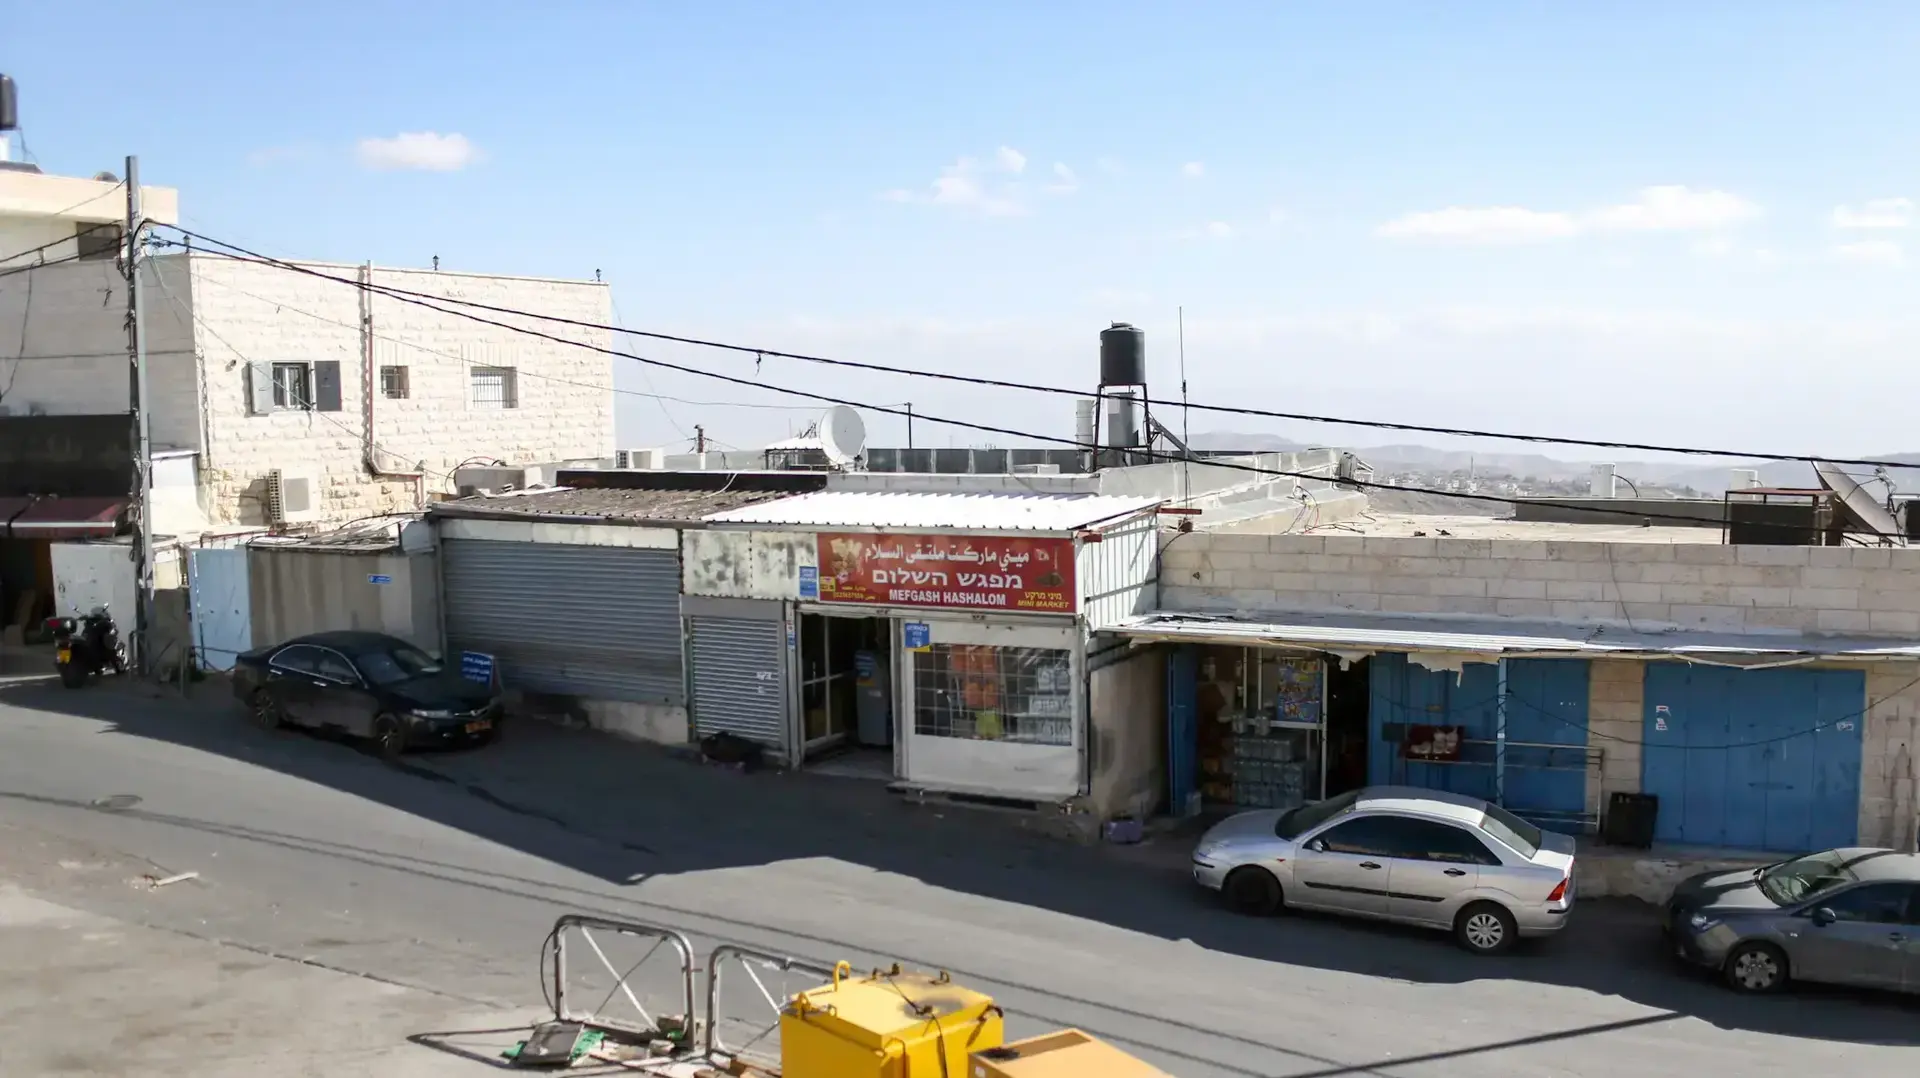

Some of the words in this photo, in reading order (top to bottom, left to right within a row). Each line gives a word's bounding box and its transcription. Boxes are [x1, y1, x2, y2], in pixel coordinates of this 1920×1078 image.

[864, 543, 904, 563] السلام
[948, 544, 997, 566] ماركت
[999, 547, 1030, 572] ميني
[871, 567, 948, 586] השלום
[956, 571, 1023, 590] מפגש
[889, 588, 941, 603] MEFGASH
[943, 590, 1007, 606] HASHALOM
[1017, 599, 1034, 608] MINI
[1035, 600, 1070, 609] MARKET
